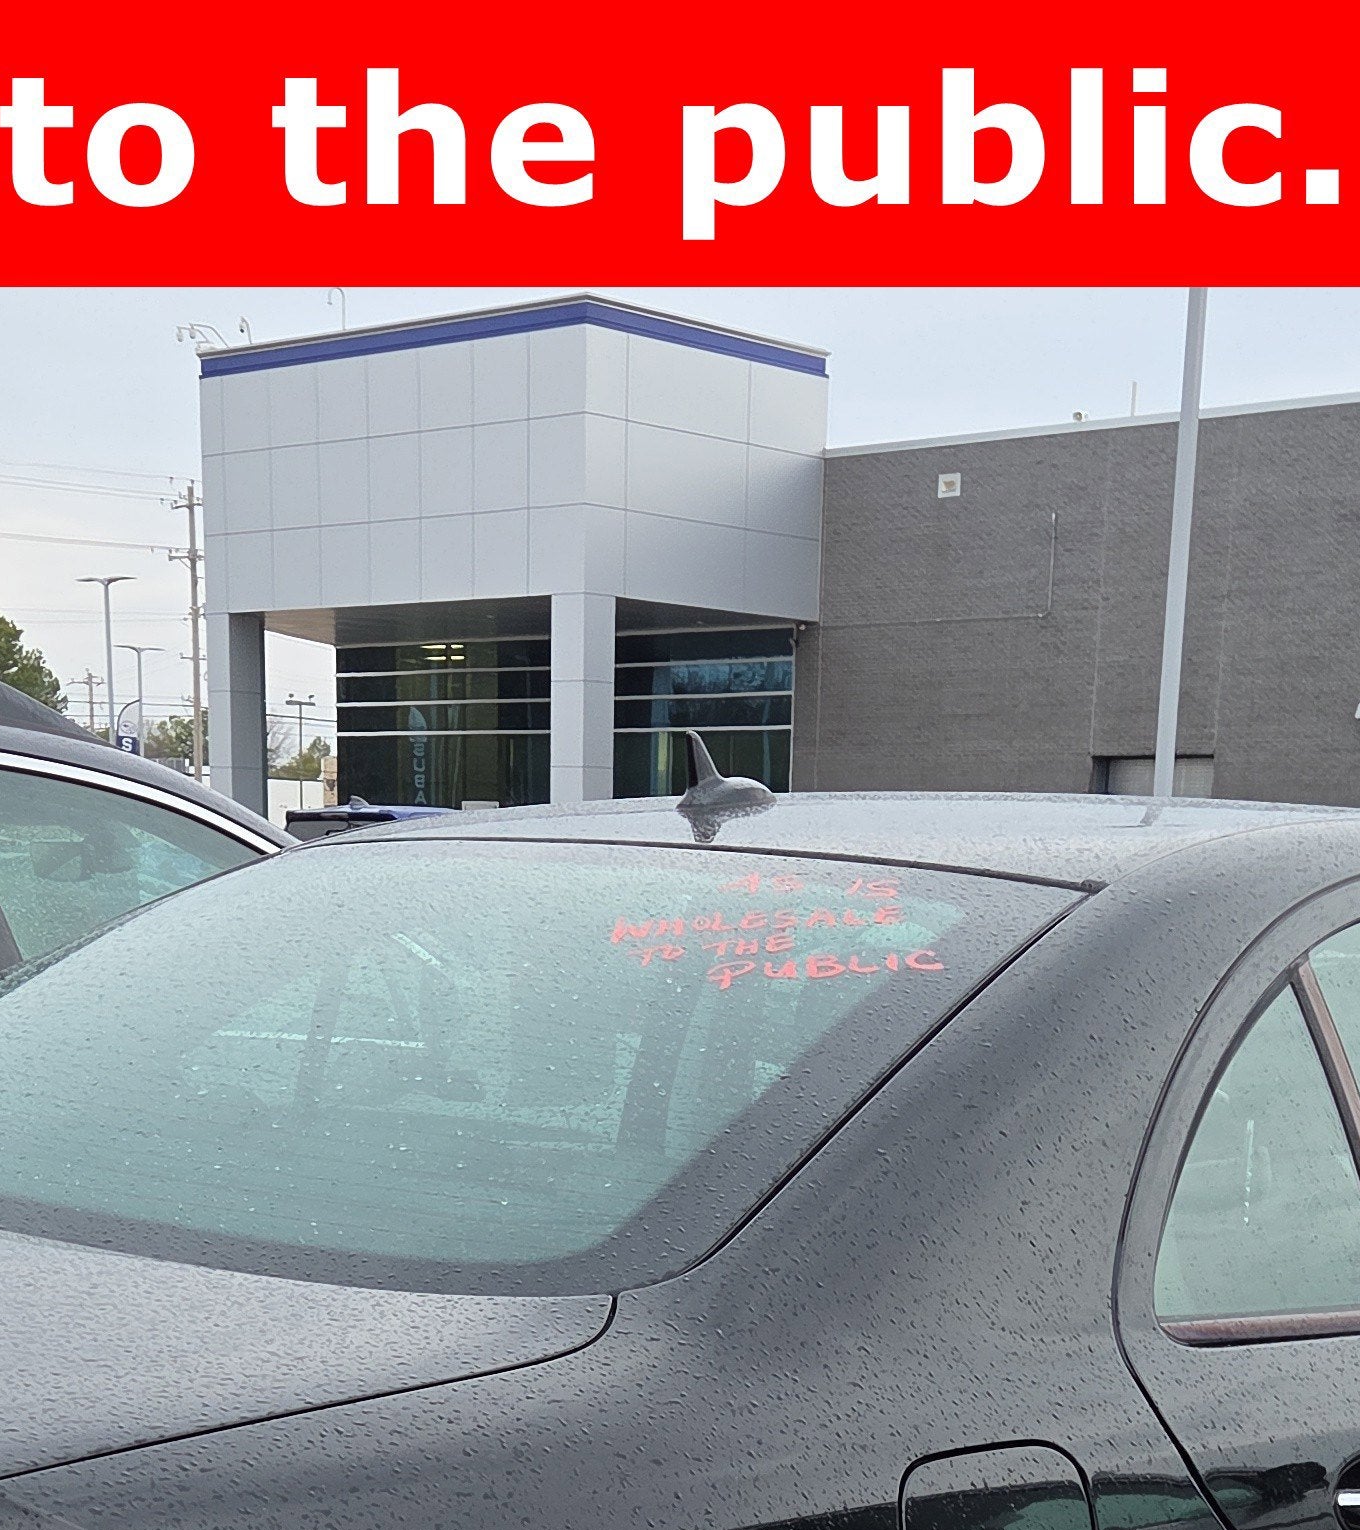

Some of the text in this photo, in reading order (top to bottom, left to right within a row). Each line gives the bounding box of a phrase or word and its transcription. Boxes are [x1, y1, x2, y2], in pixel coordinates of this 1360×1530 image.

[717, 871, 902, 899] AS IS
[611, 904, 907, 945] WHOLESALE
[627, 932, 797, 967] TO THE
[706, 949, 944, 991] PUBLIC
